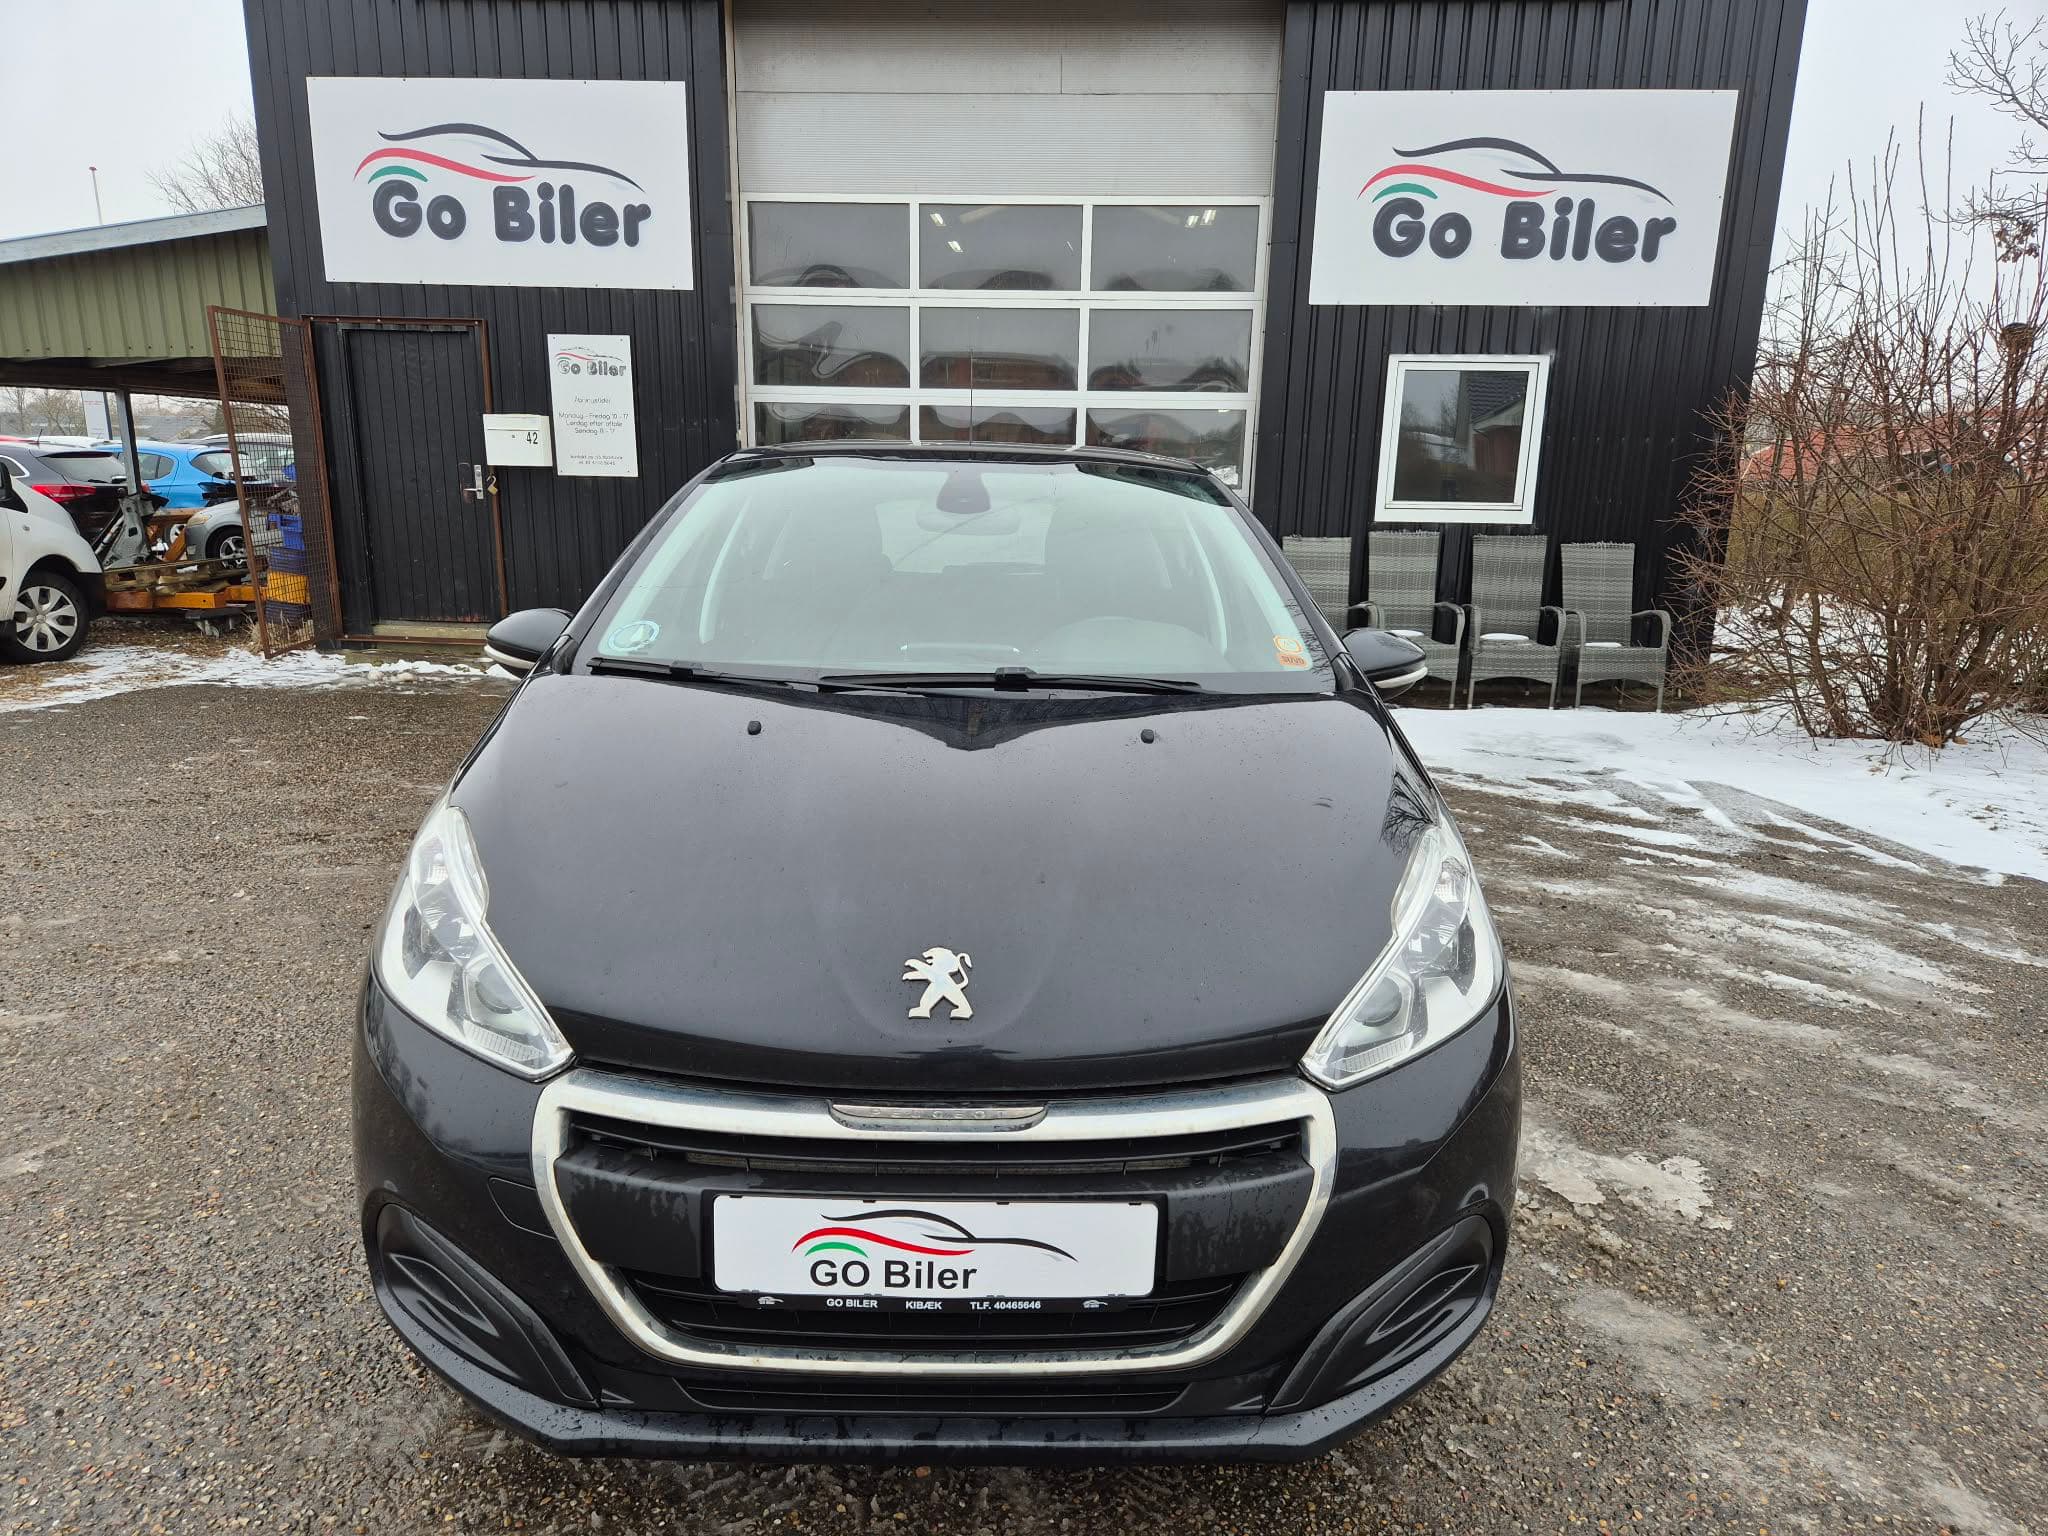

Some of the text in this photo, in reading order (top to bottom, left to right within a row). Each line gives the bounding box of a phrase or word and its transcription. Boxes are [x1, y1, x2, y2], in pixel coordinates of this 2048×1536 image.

[372, 178, 652, 248] Go Biler
[1372, 196, 1678, 264] Go Biler
[558, 360, 627, 376] Go Biler
[526, 431, 539, 445] 42
[809, 1258, 978, 1290] GO Biler
[826, 1298, 1041, 1310] GO BILER KIBÆK TLF. 40465646
